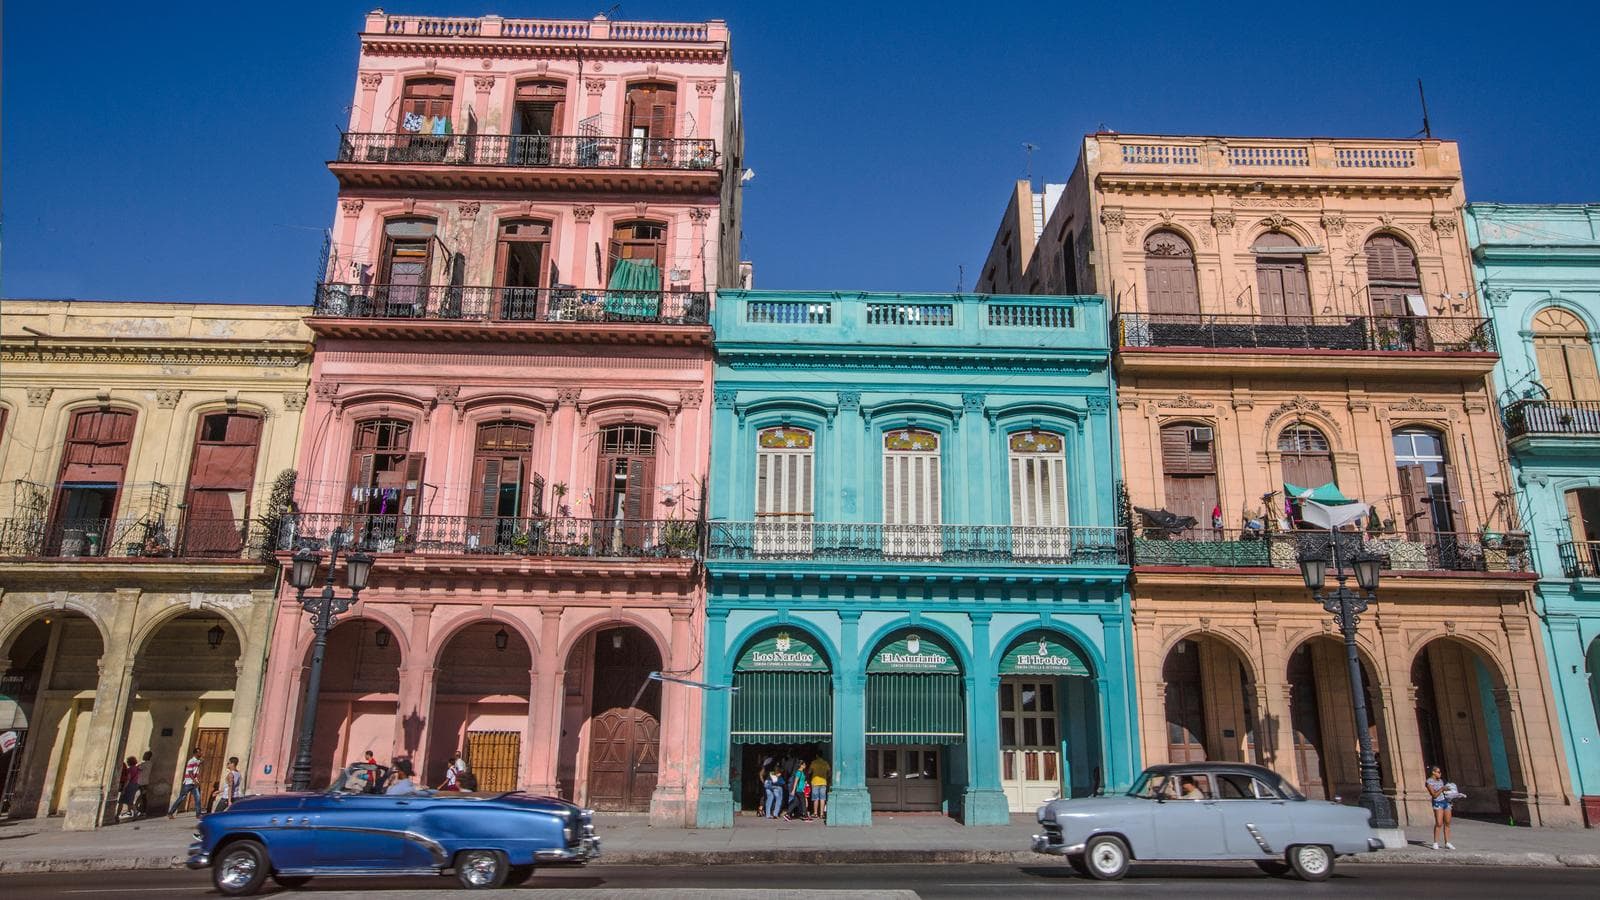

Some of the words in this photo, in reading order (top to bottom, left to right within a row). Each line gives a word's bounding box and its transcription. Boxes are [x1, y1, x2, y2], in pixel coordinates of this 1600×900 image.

[753, 652, 774, 661] Los
[774, 652, 813, 662] Nardos
[881, 653, 893, 663] El
[893, 653, 947, 664] Asturianito
[1017, 655, 1031, 664] El
[1031, 655, 1068, 665] Trofeo
